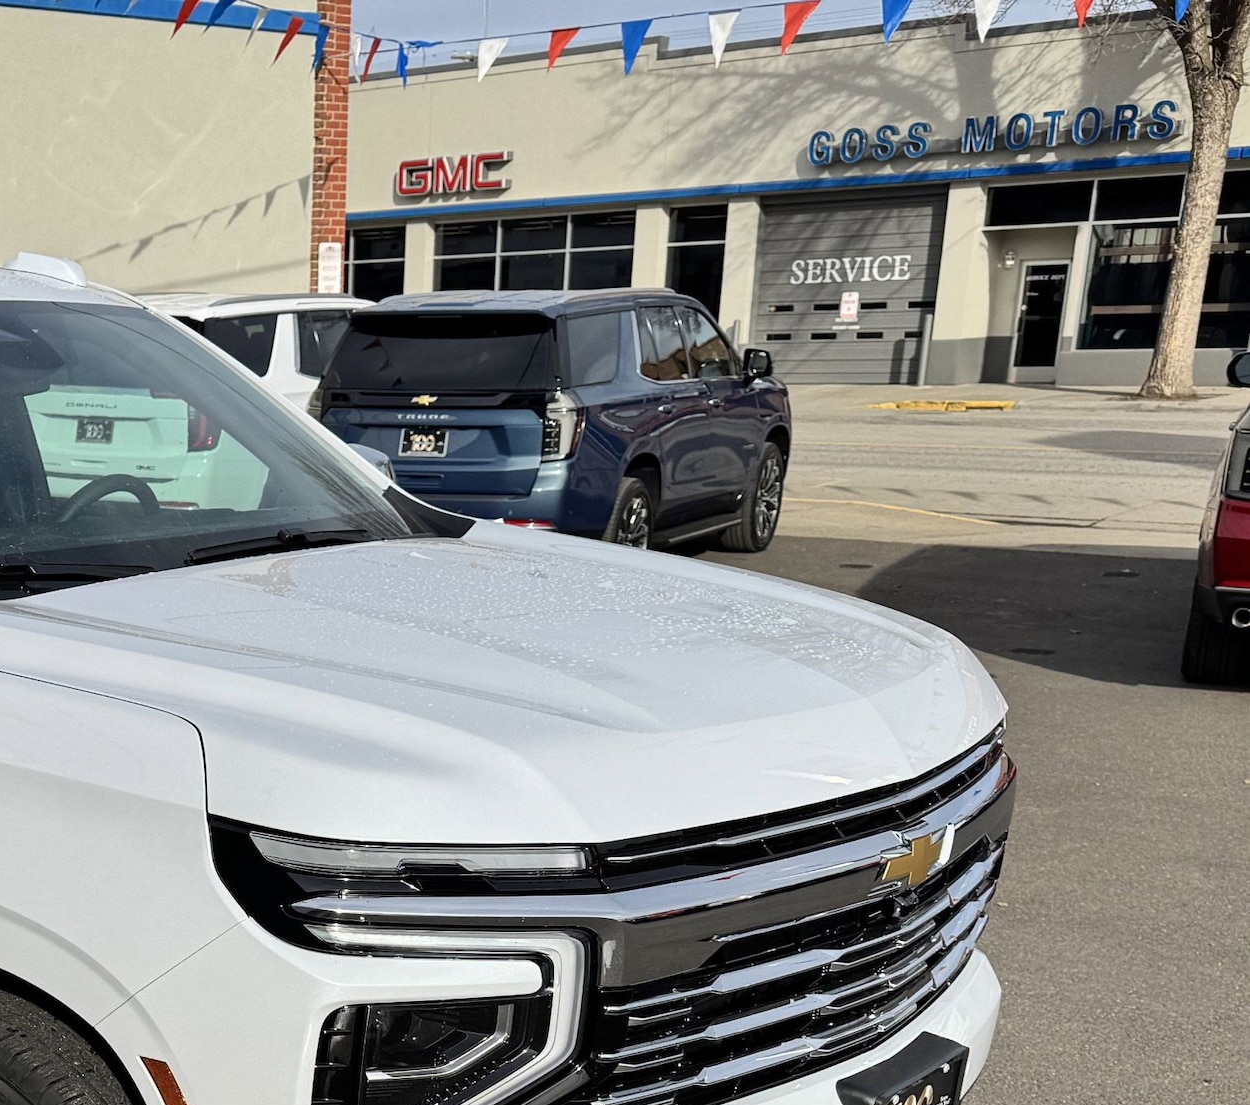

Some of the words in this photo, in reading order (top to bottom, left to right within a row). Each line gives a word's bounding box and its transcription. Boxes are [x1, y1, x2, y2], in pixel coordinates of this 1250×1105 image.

[808, 121, 932, 167] GOSS
[961, 100, 1180, 154] MOTORS
[396, 150, 513, 197] GMC
[790, 254, 912, 285] SERVICE
[65, 401, 117, 409] DENALI
[409, 434, 436, 452] 100
